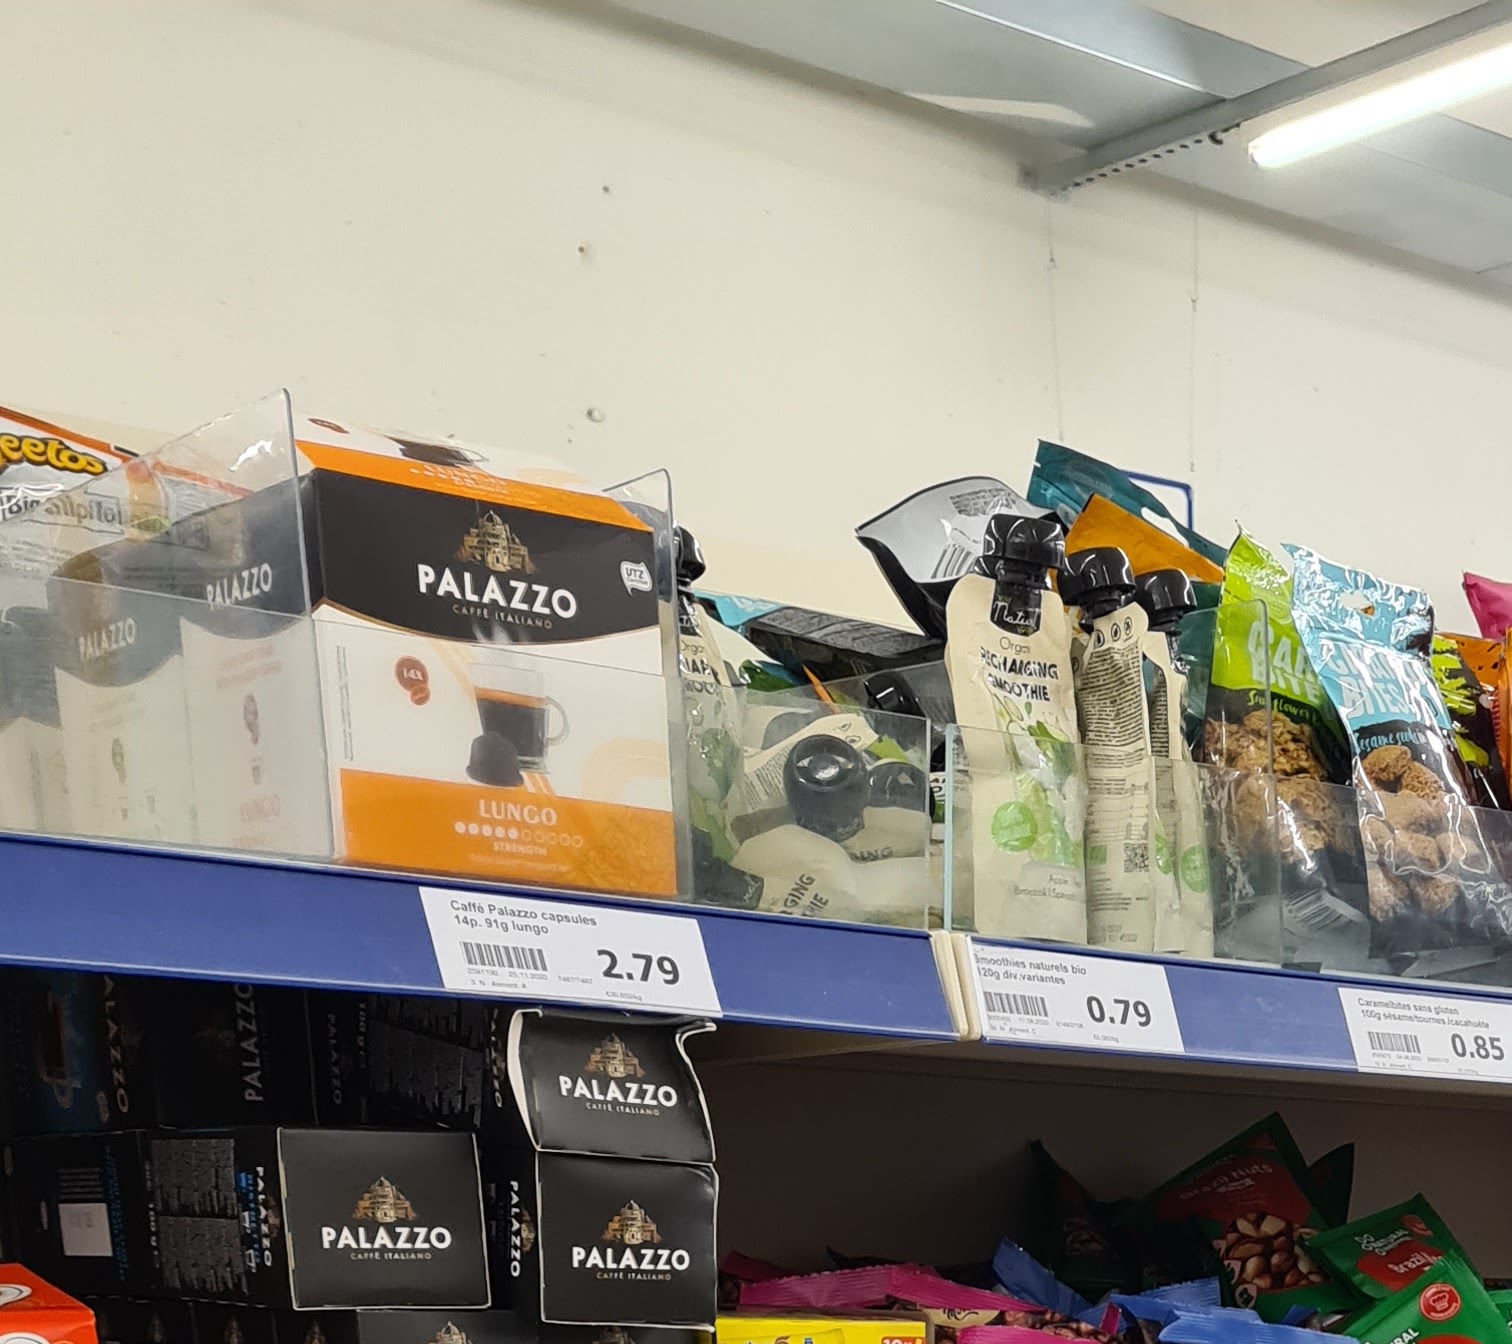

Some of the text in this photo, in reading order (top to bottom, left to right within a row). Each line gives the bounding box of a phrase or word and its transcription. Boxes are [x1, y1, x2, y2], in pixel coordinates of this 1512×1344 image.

[417, 562, 578, 621] PALAZZO
[493, 611, 553, 630] ITALIANO
[478, 798, 558, 827] LUNGO
[453, 914, 550, 936] 14p. 91g lungo
[487, 903, 597, 926] Palazzo capsules
[597, 948, 680, 985] 2.79
[974, 953, 1087, 976] Smoothies naturels bio
[1002, 969, 1066, 987] div.variantes
[1086, 995, 1152, 1028] 0.79
[1450, 1032, 1505, 1061] 0.85
[558, 1073, 678, 1108] PALAZZO
[321, 1225, 452, 1251] PALAZZO
[571, 1245, 691, 1272] PALAZZO
